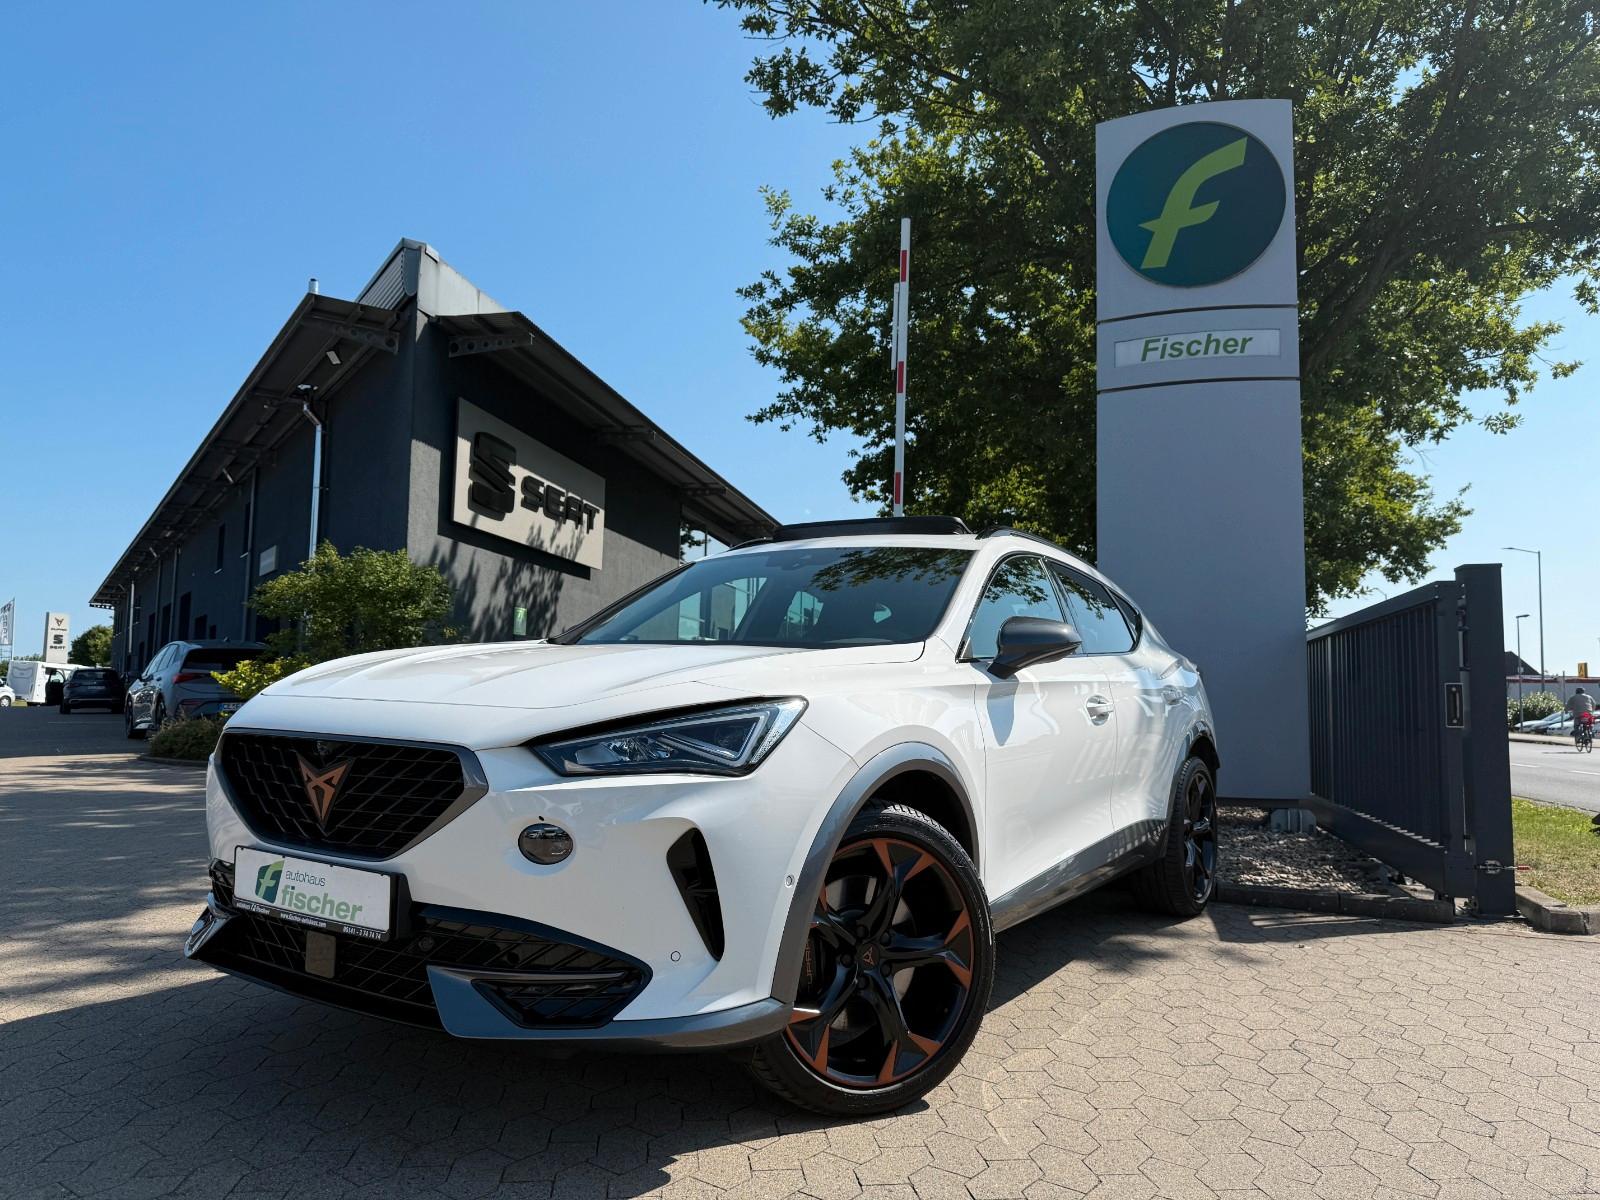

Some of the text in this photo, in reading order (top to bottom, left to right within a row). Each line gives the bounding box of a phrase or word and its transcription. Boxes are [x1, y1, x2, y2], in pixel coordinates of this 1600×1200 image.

[1140, 333, 1254, 362] Fischer
[520, 475, 600, 532] SEAT
[285, 870, 326, 887] autohaus
[281, 884, 363, 922] fischer
